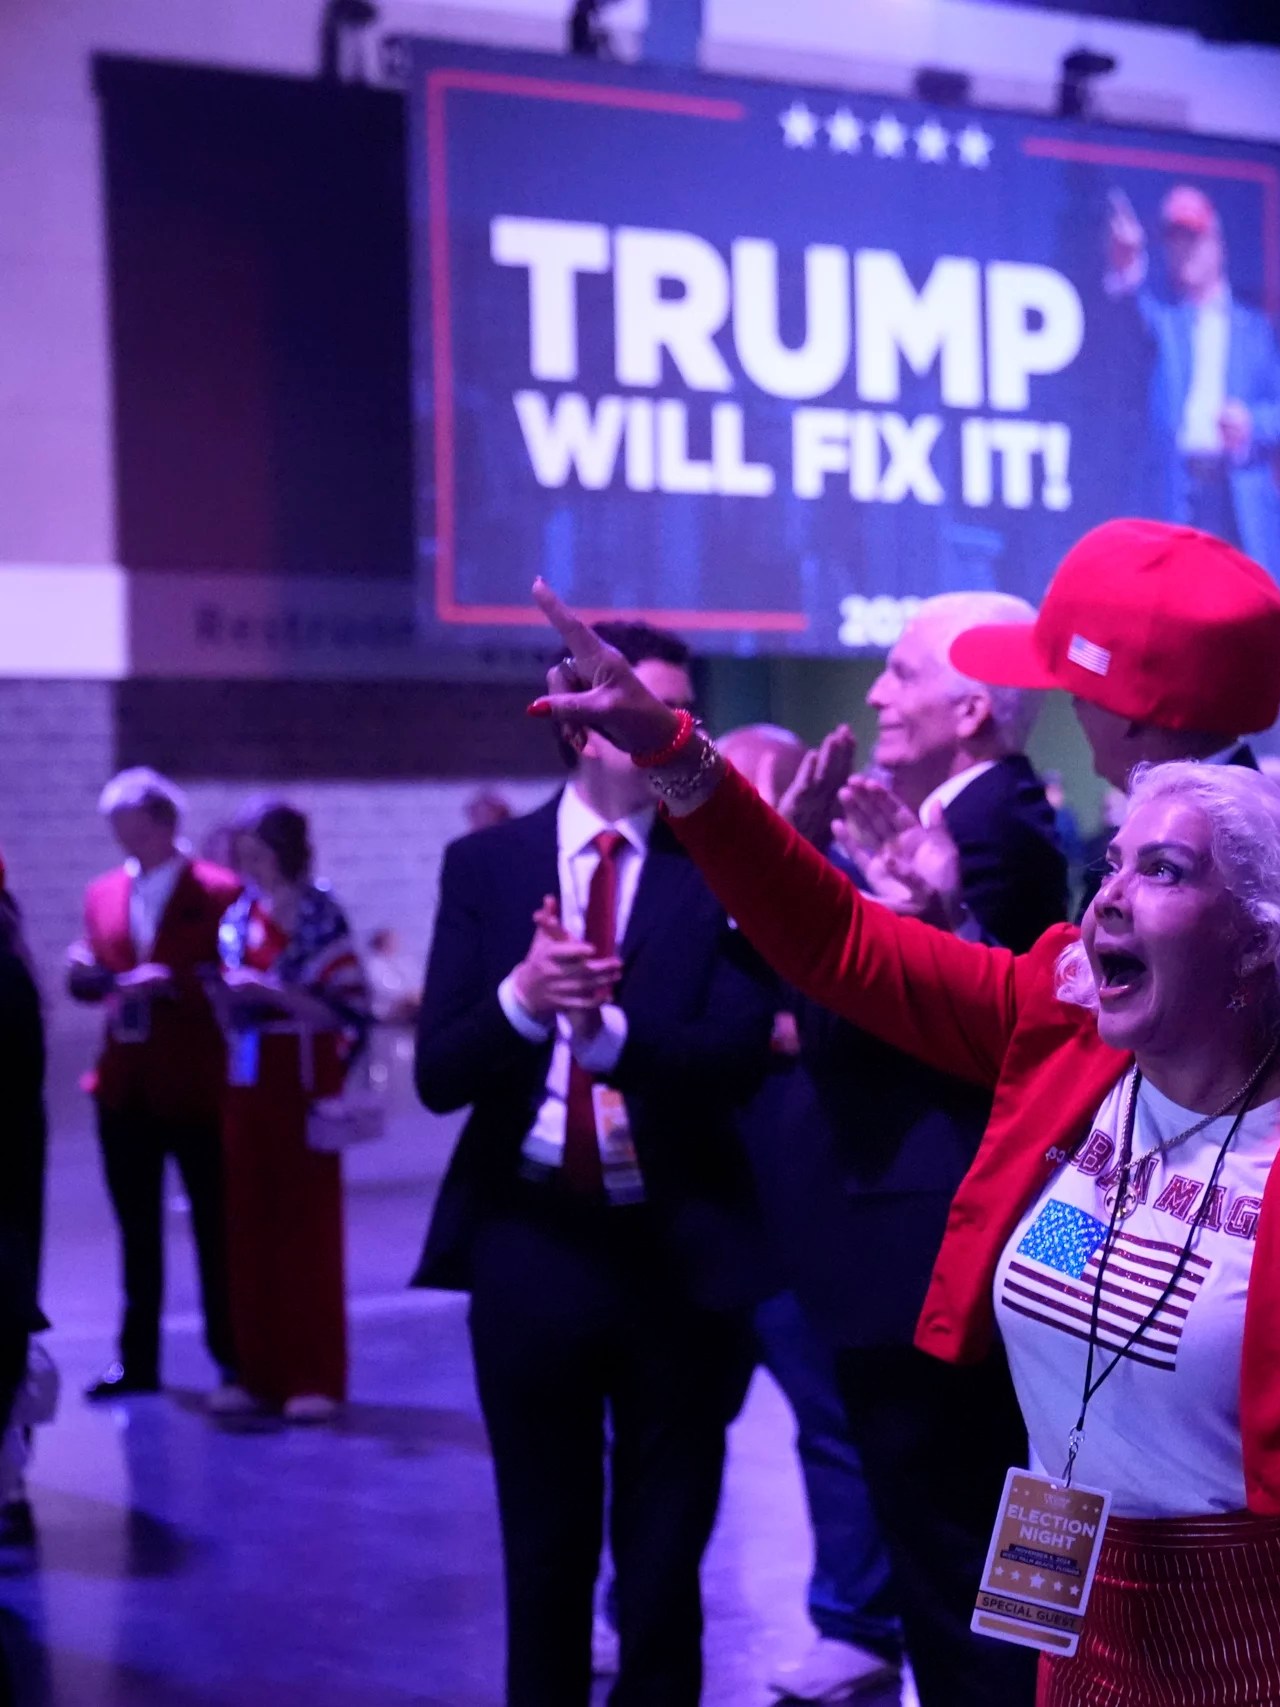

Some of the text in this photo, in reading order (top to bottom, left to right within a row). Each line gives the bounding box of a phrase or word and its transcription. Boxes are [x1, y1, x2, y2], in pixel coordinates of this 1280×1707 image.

[490, 215, 1084, 410] TRUMP
[514, 391, 1073, 511] WILL FIX IT!
[1153, 1174, 1263, 1240] MAG
[1007, 1504, 1096, 1538] ELECTION
[1019, 1526, 1076, 1550] NIGHT
[982, 1597, 1075, 1628] SPECIAL GUEST
